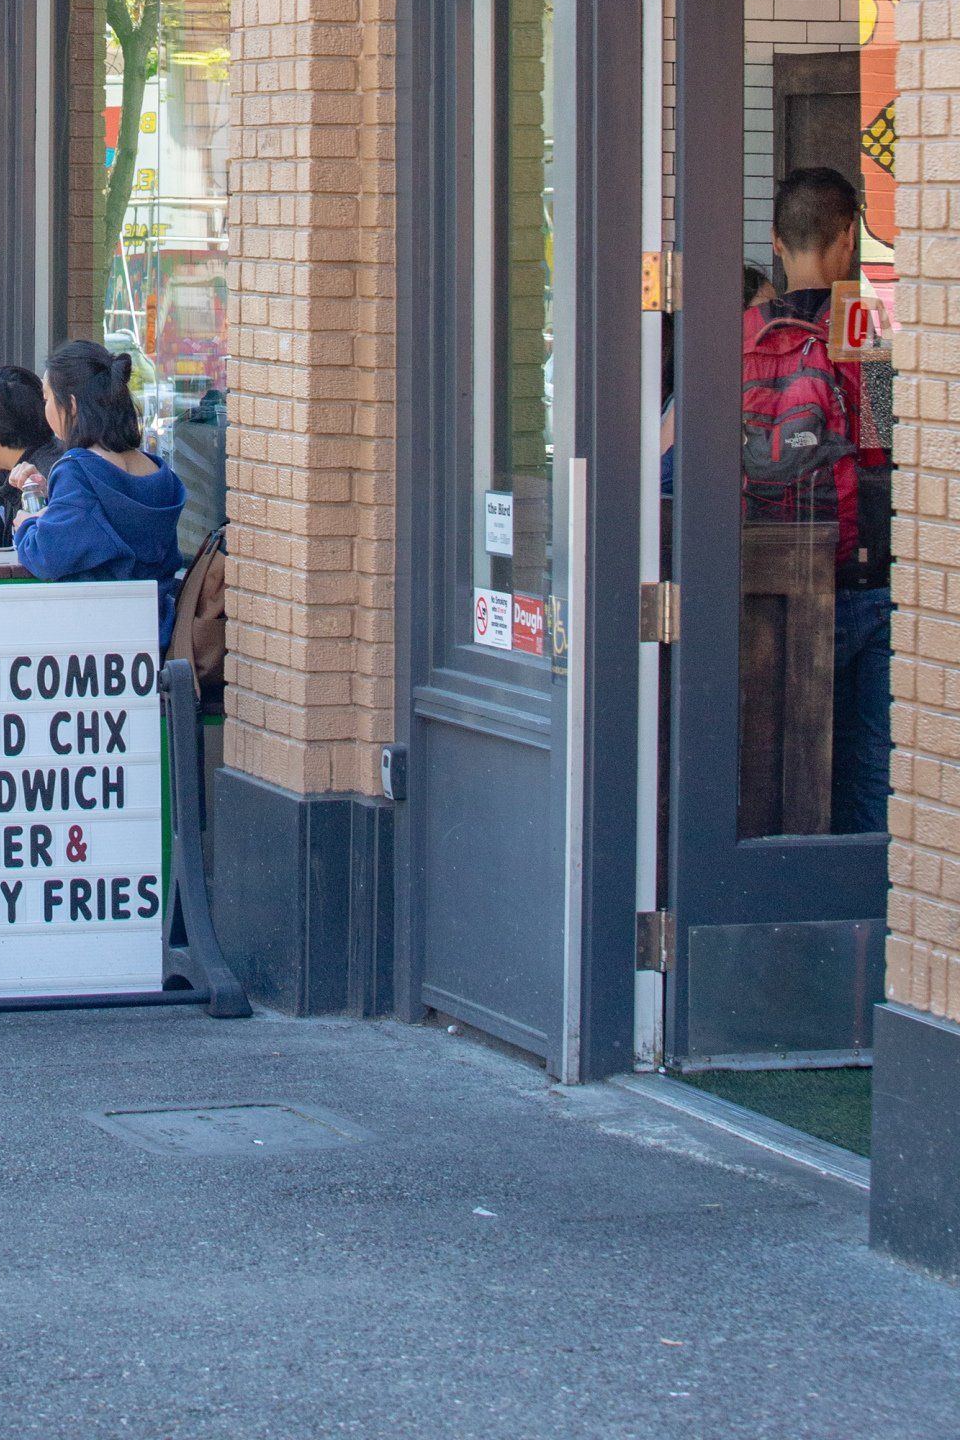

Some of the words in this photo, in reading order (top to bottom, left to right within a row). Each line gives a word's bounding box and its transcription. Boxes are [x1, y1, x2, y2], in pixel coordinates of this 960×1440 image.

[514, 602, 543, 635] Dough
[9, 652, 155, 701] COMBO
[49, 709, 128, 755] CHX
[66, 824, 88, 863] &
[43, 875, 160, 923] FRIES
